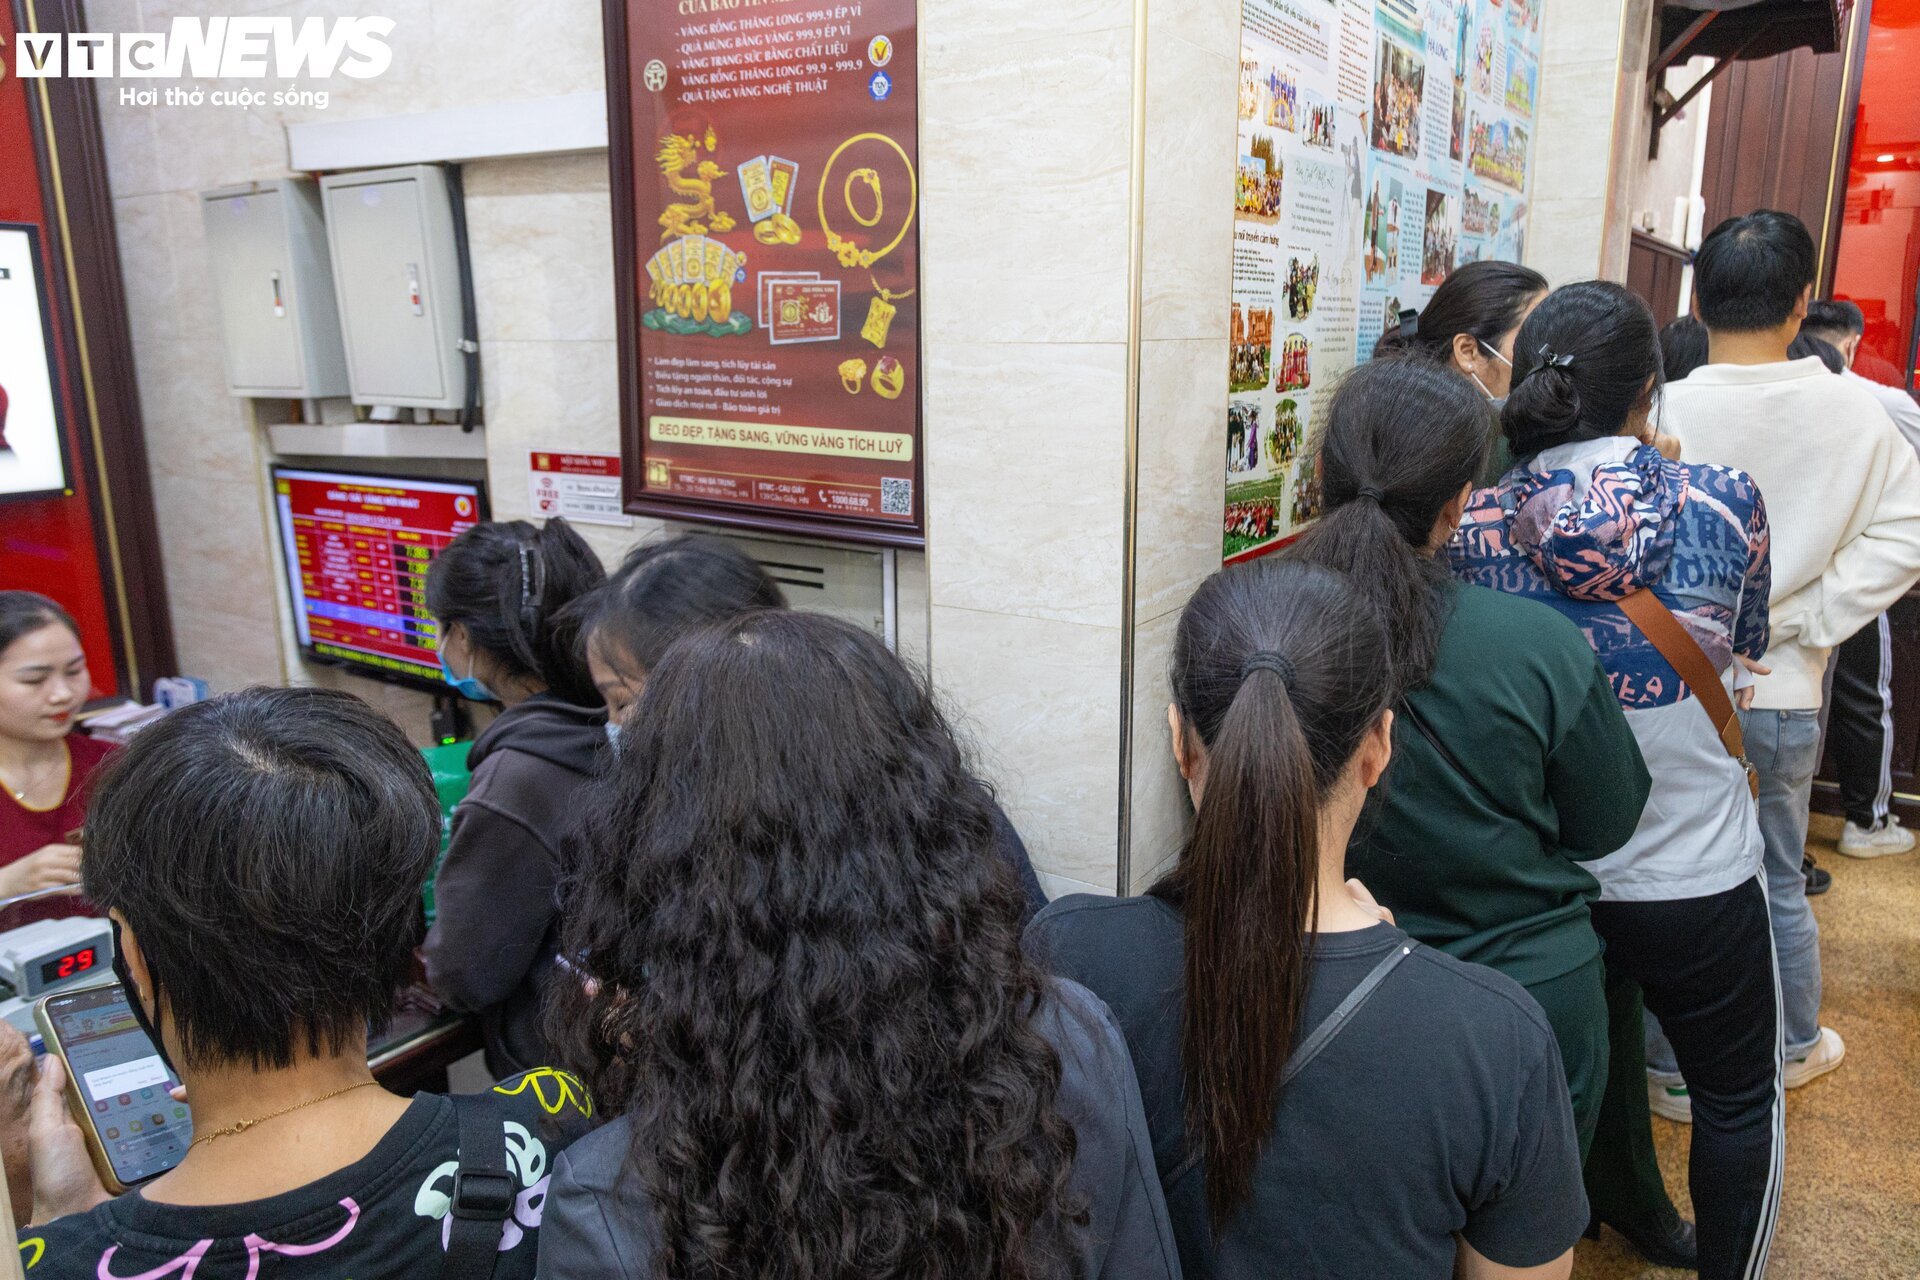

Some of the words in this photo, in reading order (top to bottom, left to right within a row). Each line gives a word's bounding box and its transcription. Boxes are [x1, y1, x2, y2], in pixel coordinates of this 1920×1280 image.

[680, 23, 707, 37] VÀNG
[776, 13, 804, 26] LONG
[806, 9, 832, 22] 999.9
[835, 5, 848, 19] ÉP
[681, 40, 702, 55] QUÀ
[765, 30, 793, 44] VÀNG
[796, 27, 822, 40] 999.9
[825, 24, 837, 37] ÉP
[681, 56, 709, 70] VÀNG
[711, 53, 743, 67] TRANG
[795, 41, 823, 57] CHẤT
[825, 41, 848, 56] LIỆU
[681, 73, 709, 86] VÀNG
[776, 65, 804, 78] LONG
[806, 63, 827, 75] 99.9
[836, 59, 863, 71] 999.9
[682, 89, 704, 105] QUÀ
[704, 87, 732, 102] TẶNG
[733, 84, 761, 98] VÀNG
[763, 80, 792, 96] NGHỆ
[795, 77, 828, 94] THUẬT
[658, 423, 680, 436] ĐEO
[708, 427, 736, 442] TẶNG
[738, 429, 773, 446] SANG,
[775, 429, 808, 446] VỮNG
[812, 432, 844, 449] VÀNG
[848, 434, 875, 452] TÍCH
[57, 948, 94, 979] 29
